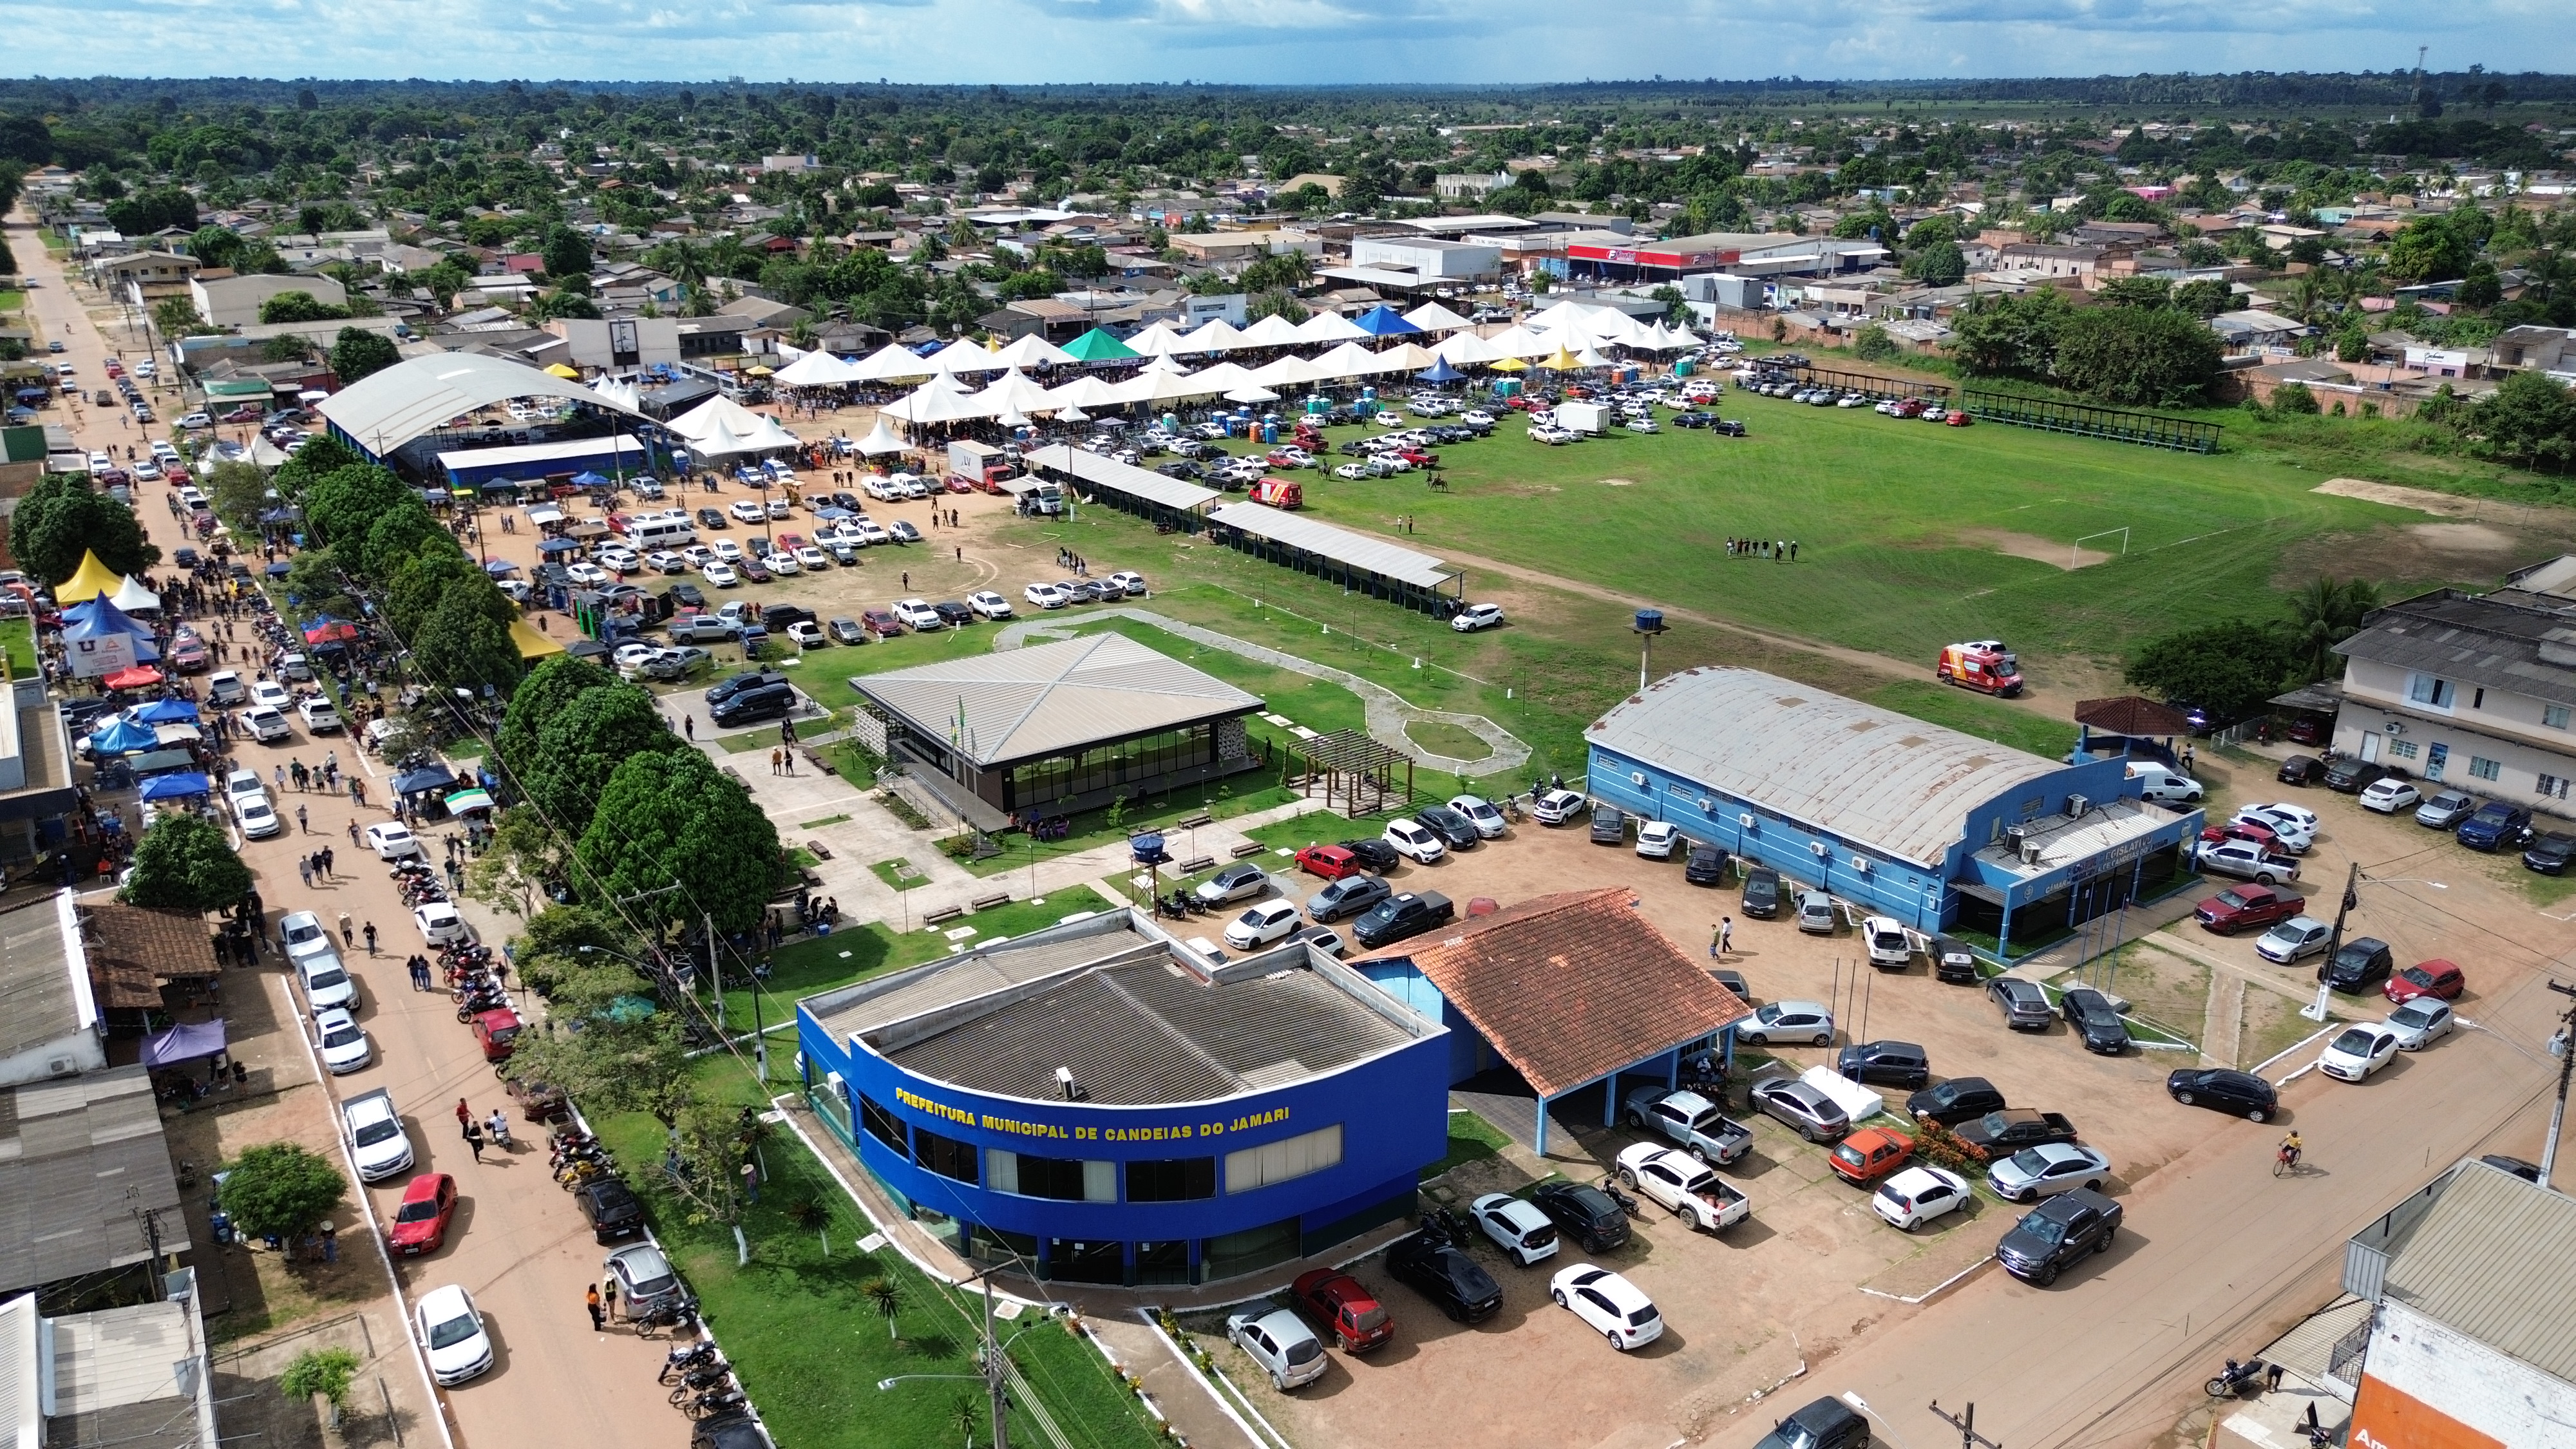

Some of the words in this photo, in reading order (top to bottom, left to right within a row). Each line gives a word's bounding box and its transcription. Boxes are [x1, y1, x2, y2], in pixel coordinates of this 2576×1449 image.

[2111, 850, 2139, 867] CANDEIAS
[895, 1087, 976, 1126] PREFEITURA
[982, 1115, 1068, 1139] MUNICIPAL
[1075, 1127, 1098, 1141] DE
[1104, 1126, 1193, 1141] CANDEIAS
[1200, 1123, 1224, 1137] DO
[1229, 1107, 1290, 1132] JAMARI
